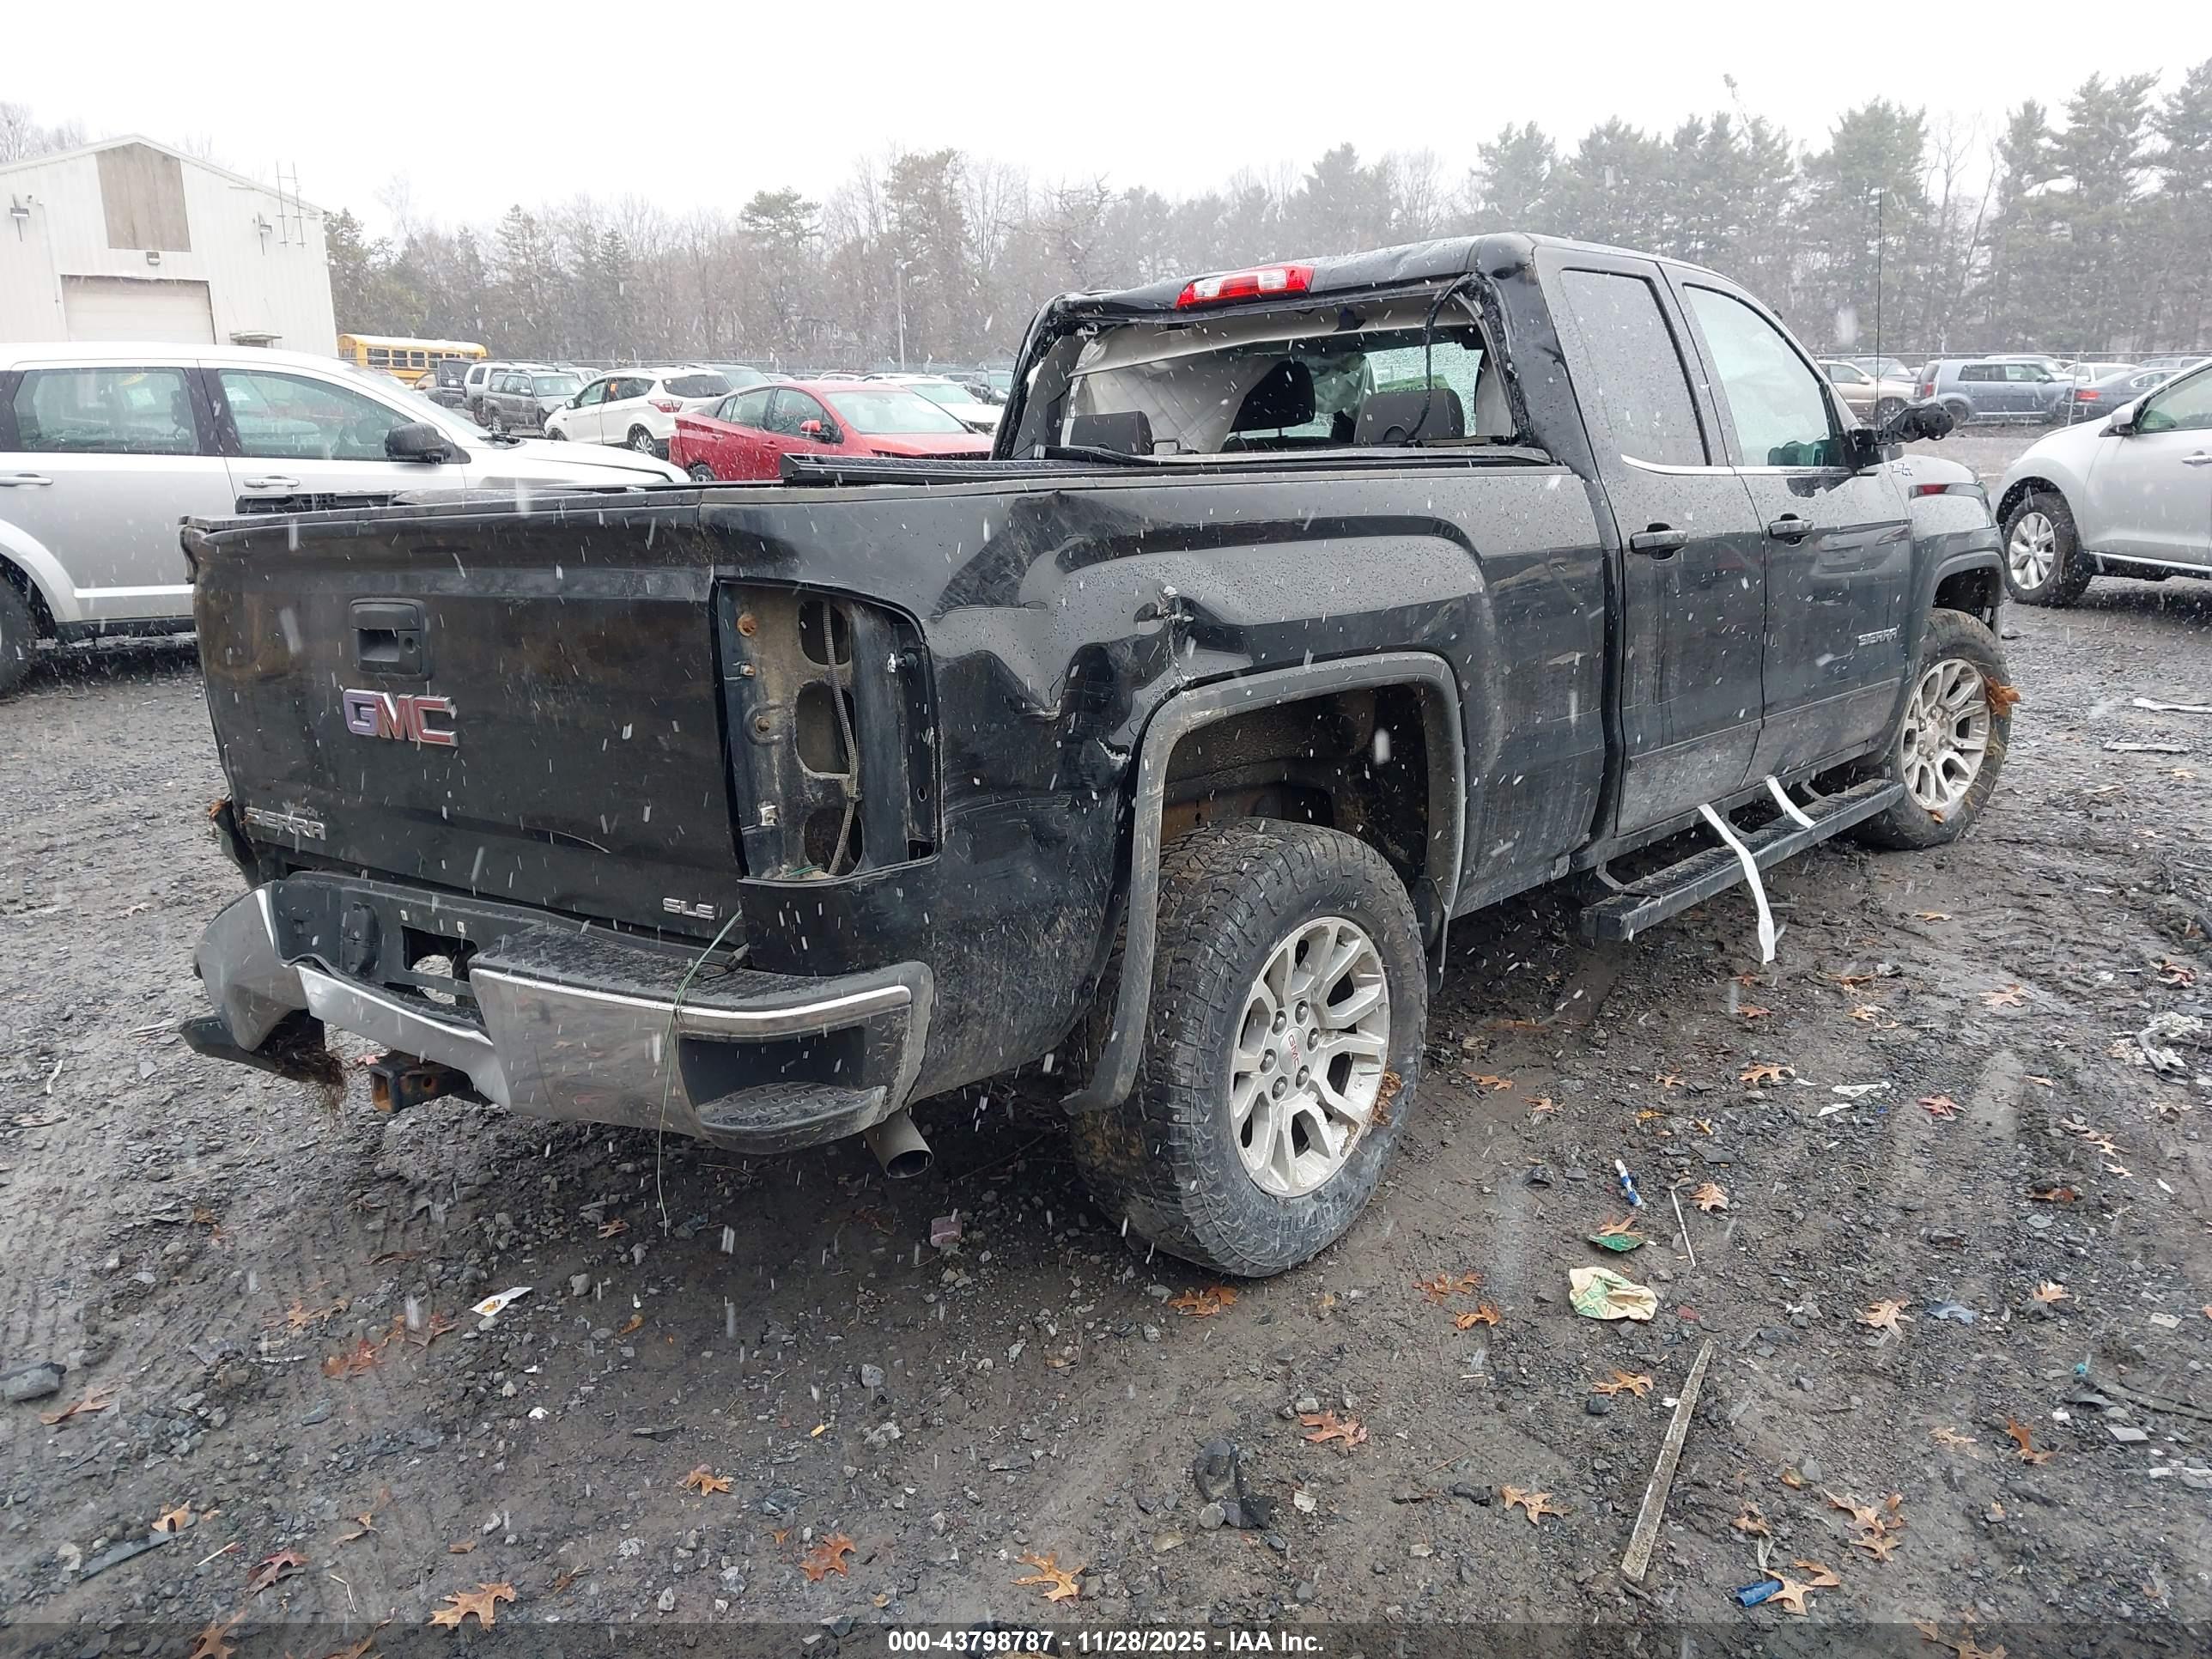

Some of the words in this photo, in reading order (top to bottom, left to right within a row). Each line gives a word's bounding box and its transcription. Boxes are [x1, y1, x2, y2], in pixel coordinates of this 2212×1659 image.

[1857, 627, 1898, 647] SIERRA
[343, 688, 459, 747] GMC
[244, 806, 326, 841] SIERRA
[662, 897, 715, 921] SLE
